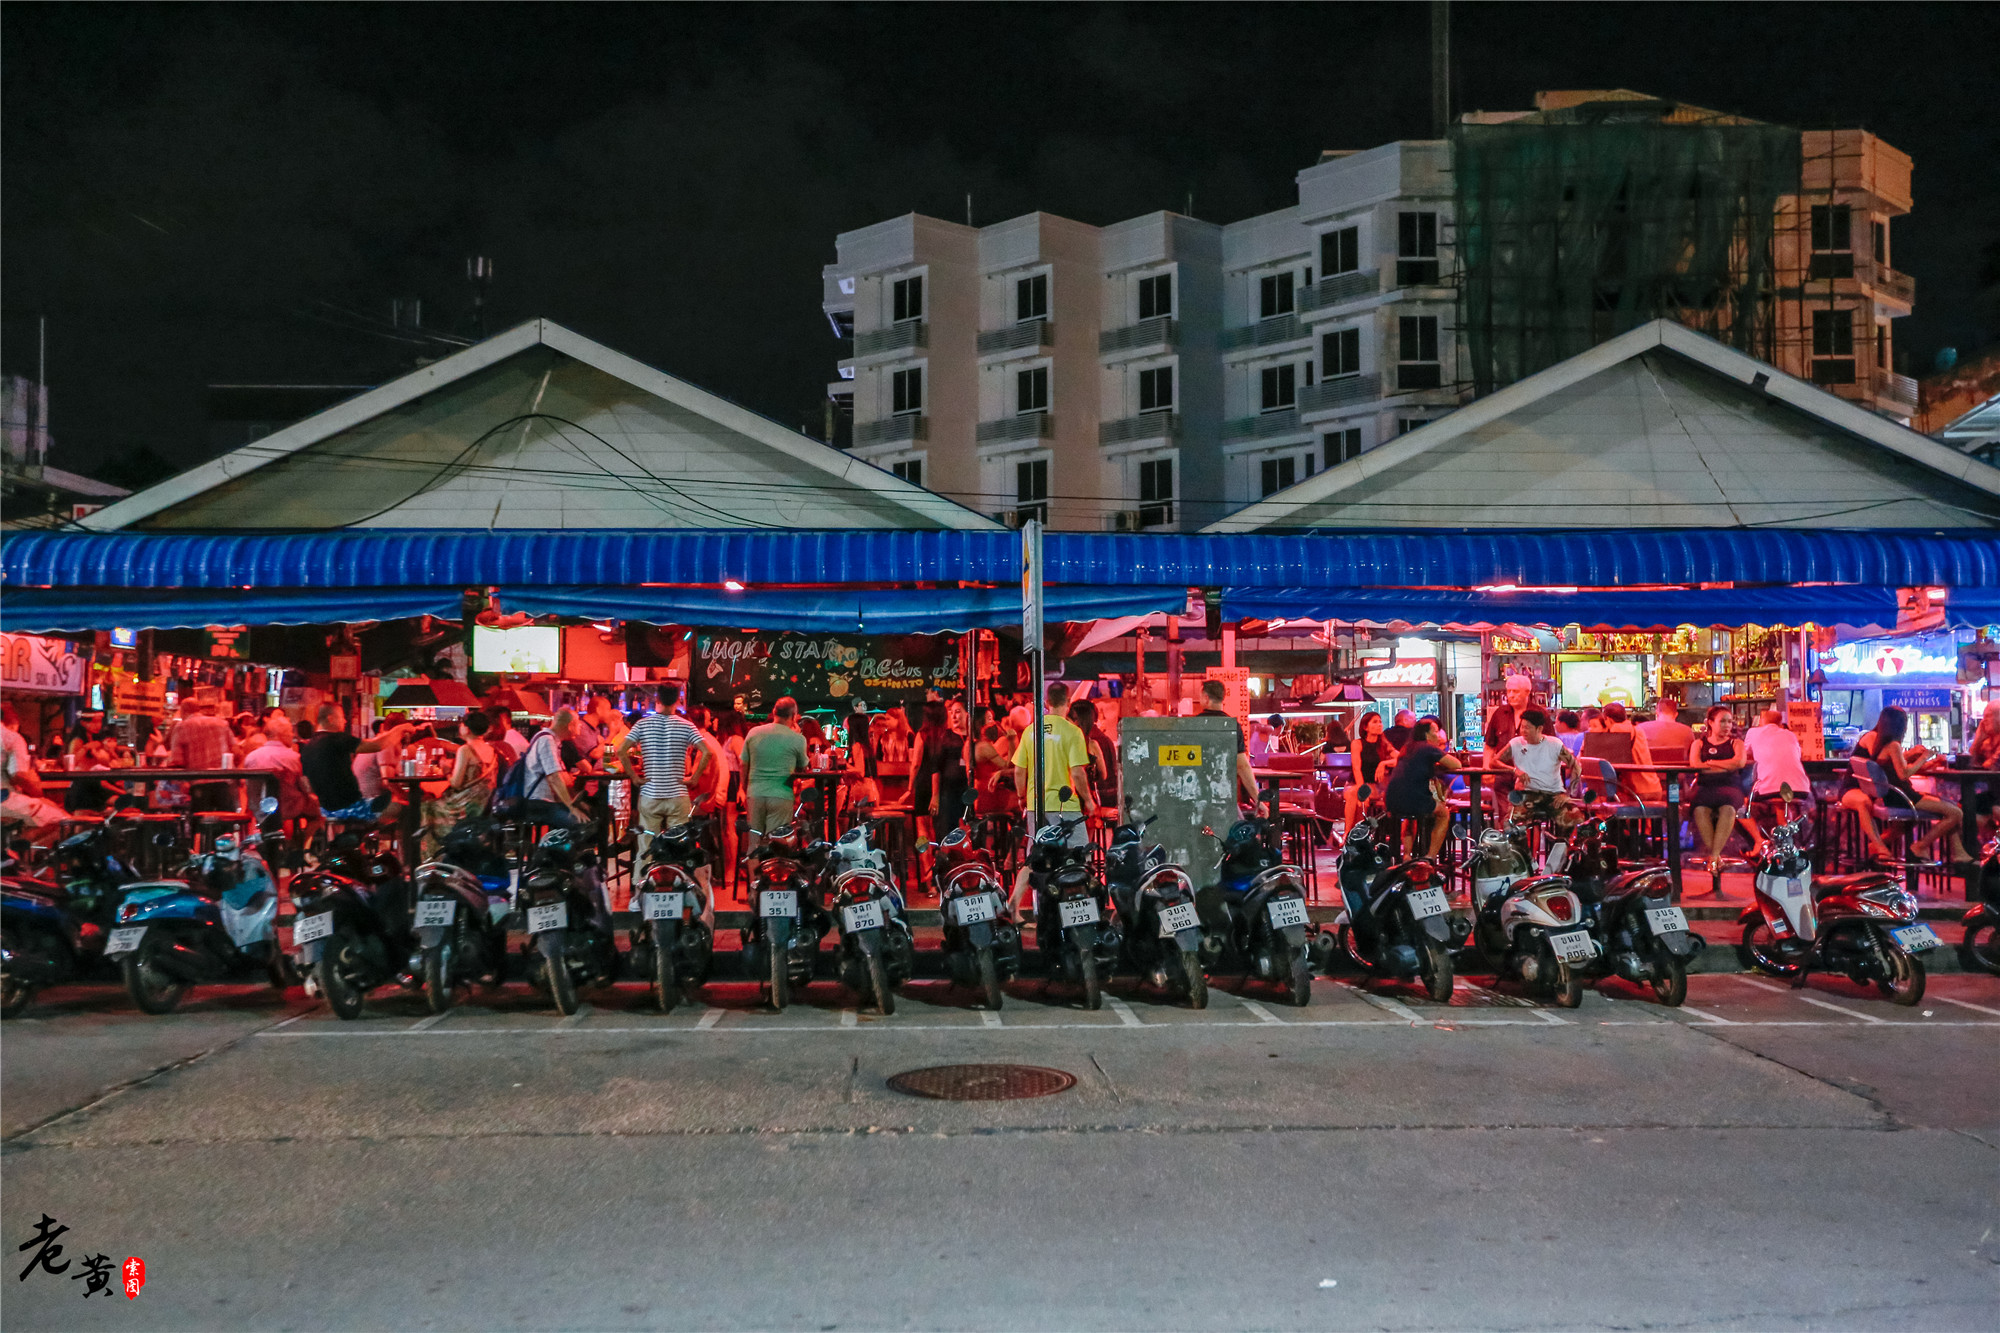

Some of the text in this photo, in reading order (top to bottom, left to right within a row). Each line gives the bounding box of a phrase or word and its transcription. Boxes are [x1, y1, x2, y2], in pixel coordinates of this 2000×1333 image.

[1891, 697, 1940, 706] HAPPINESS
[1187, 750, 1196, 761] 6
[1423, 905, 1441, 914] 170
[967, 912, 986, 922] 231
[1071, 914, 1090, 923] 733
[1282, 916, 1300, 925] 120
[855, 919, 875, 928] 870
[1171, 919, 1191, 930] 960
